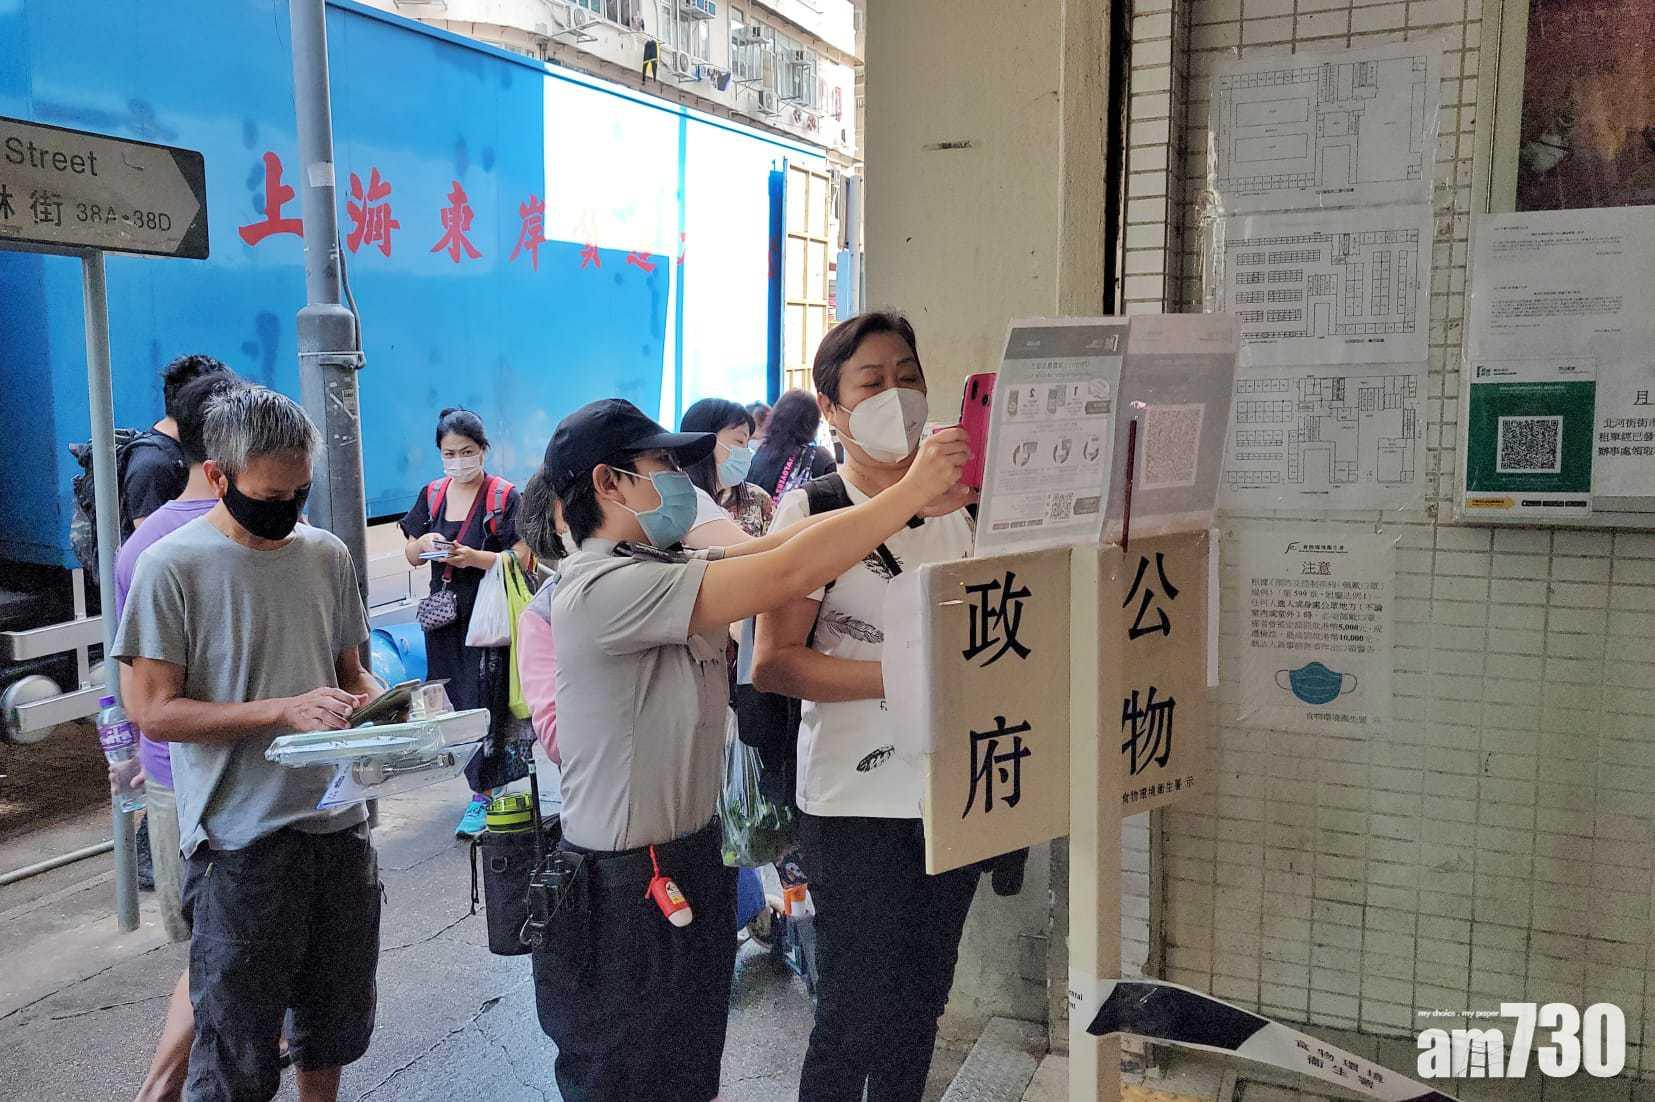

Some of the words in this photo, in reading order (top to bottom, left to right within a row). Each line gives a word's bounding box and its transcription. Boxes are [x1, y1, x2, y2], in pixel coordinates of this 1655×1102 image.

[5, 137, 98, 176] Street
[1302, 561, 1332, 575] 注意
[962, 571, 1032, 819] 政府
[1121, 552, 1179, 776] 公物
